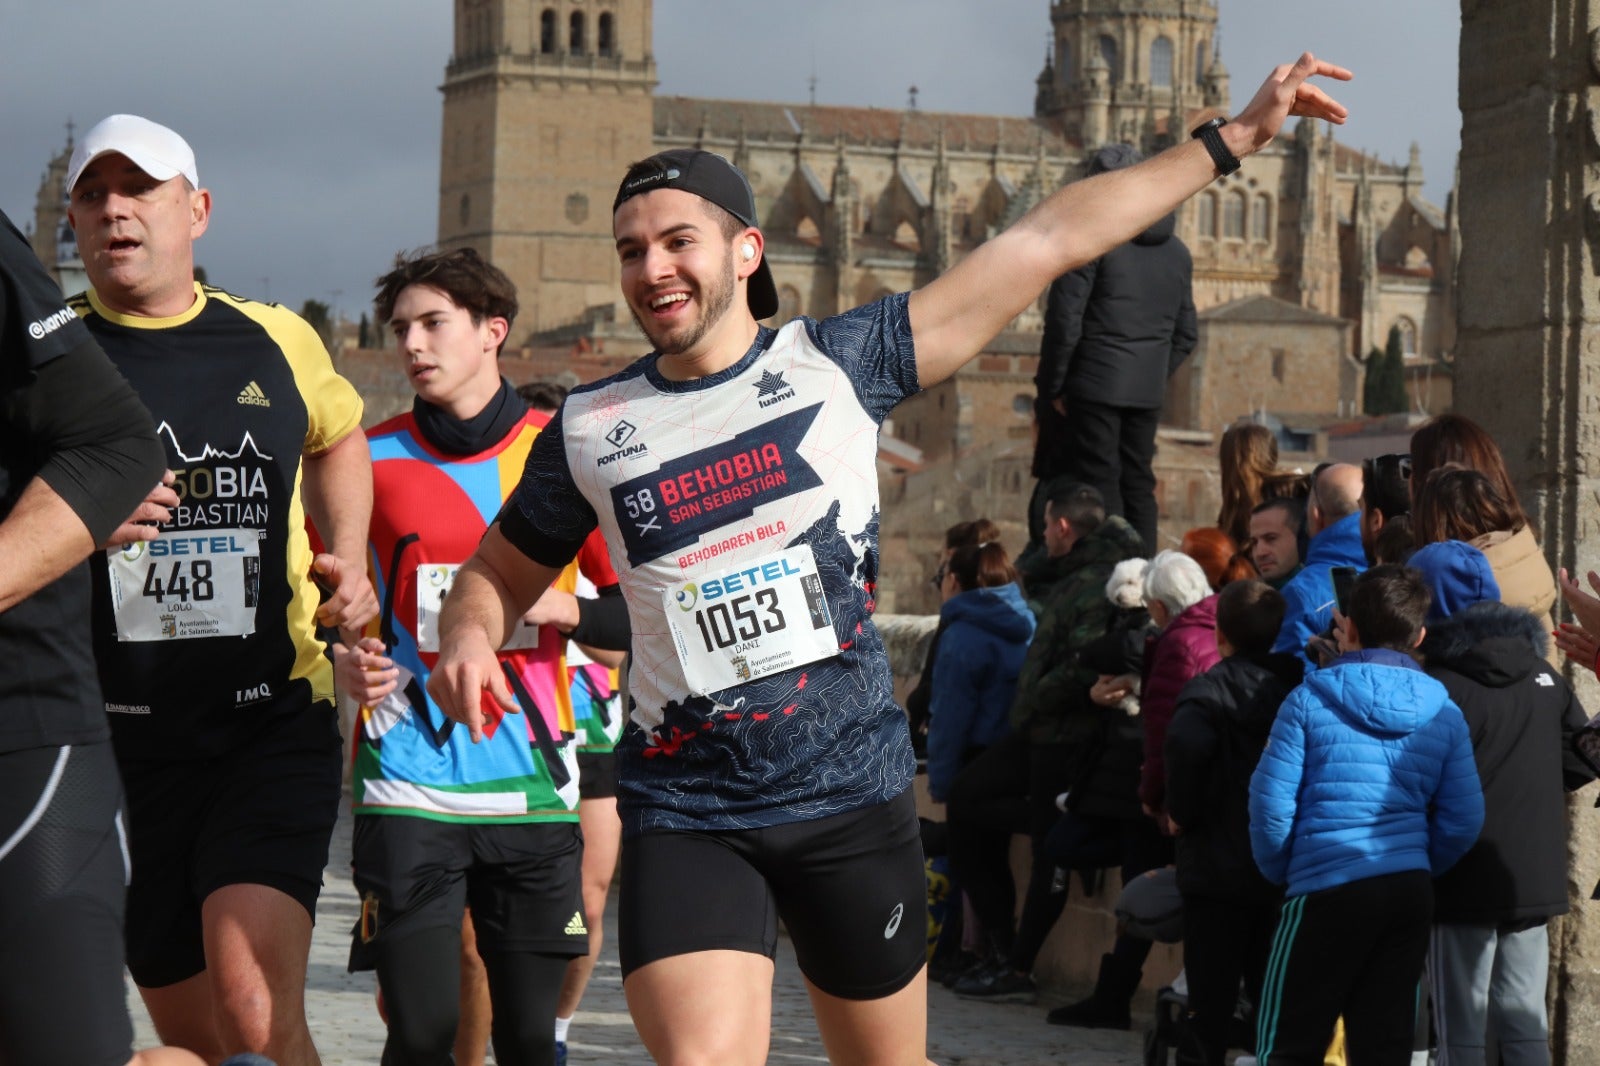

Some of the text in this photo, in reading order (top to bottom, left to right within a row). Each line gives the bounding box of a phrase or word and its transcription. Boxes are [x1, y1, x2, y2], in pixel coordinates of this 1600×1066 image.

[237, 394, 270, 407] adidas
[759, 388, 795, 409] luanvi
[597, 443, 647, 467] FORTUNA
[658, 443, 783, 506] BEHOBIA
[624, 488, 655, 518] 58
[668, 469, 788, 524] SAN SEBASTIÁN
[148, 536, 245, 557] SETEL
[678, 520, 786, 569] BEHOBIAREN BILA
[142, 559, 214, 604] 448
[701, 558, 800, 600] SETEL
[167, 602, 192, 612] LOLO
[179, 618, 219, 628] Ayuntamiento
[696, 587, 786, 652] 1053
[188, 627, 219, 636] Salamanca
[735, 639, 760, 653] DANI
[751, 650, 791, 666] Ayuntamiento
[753, 659, 794, 676] de Salamanca
[236, 683, 271, 702] IMQ
